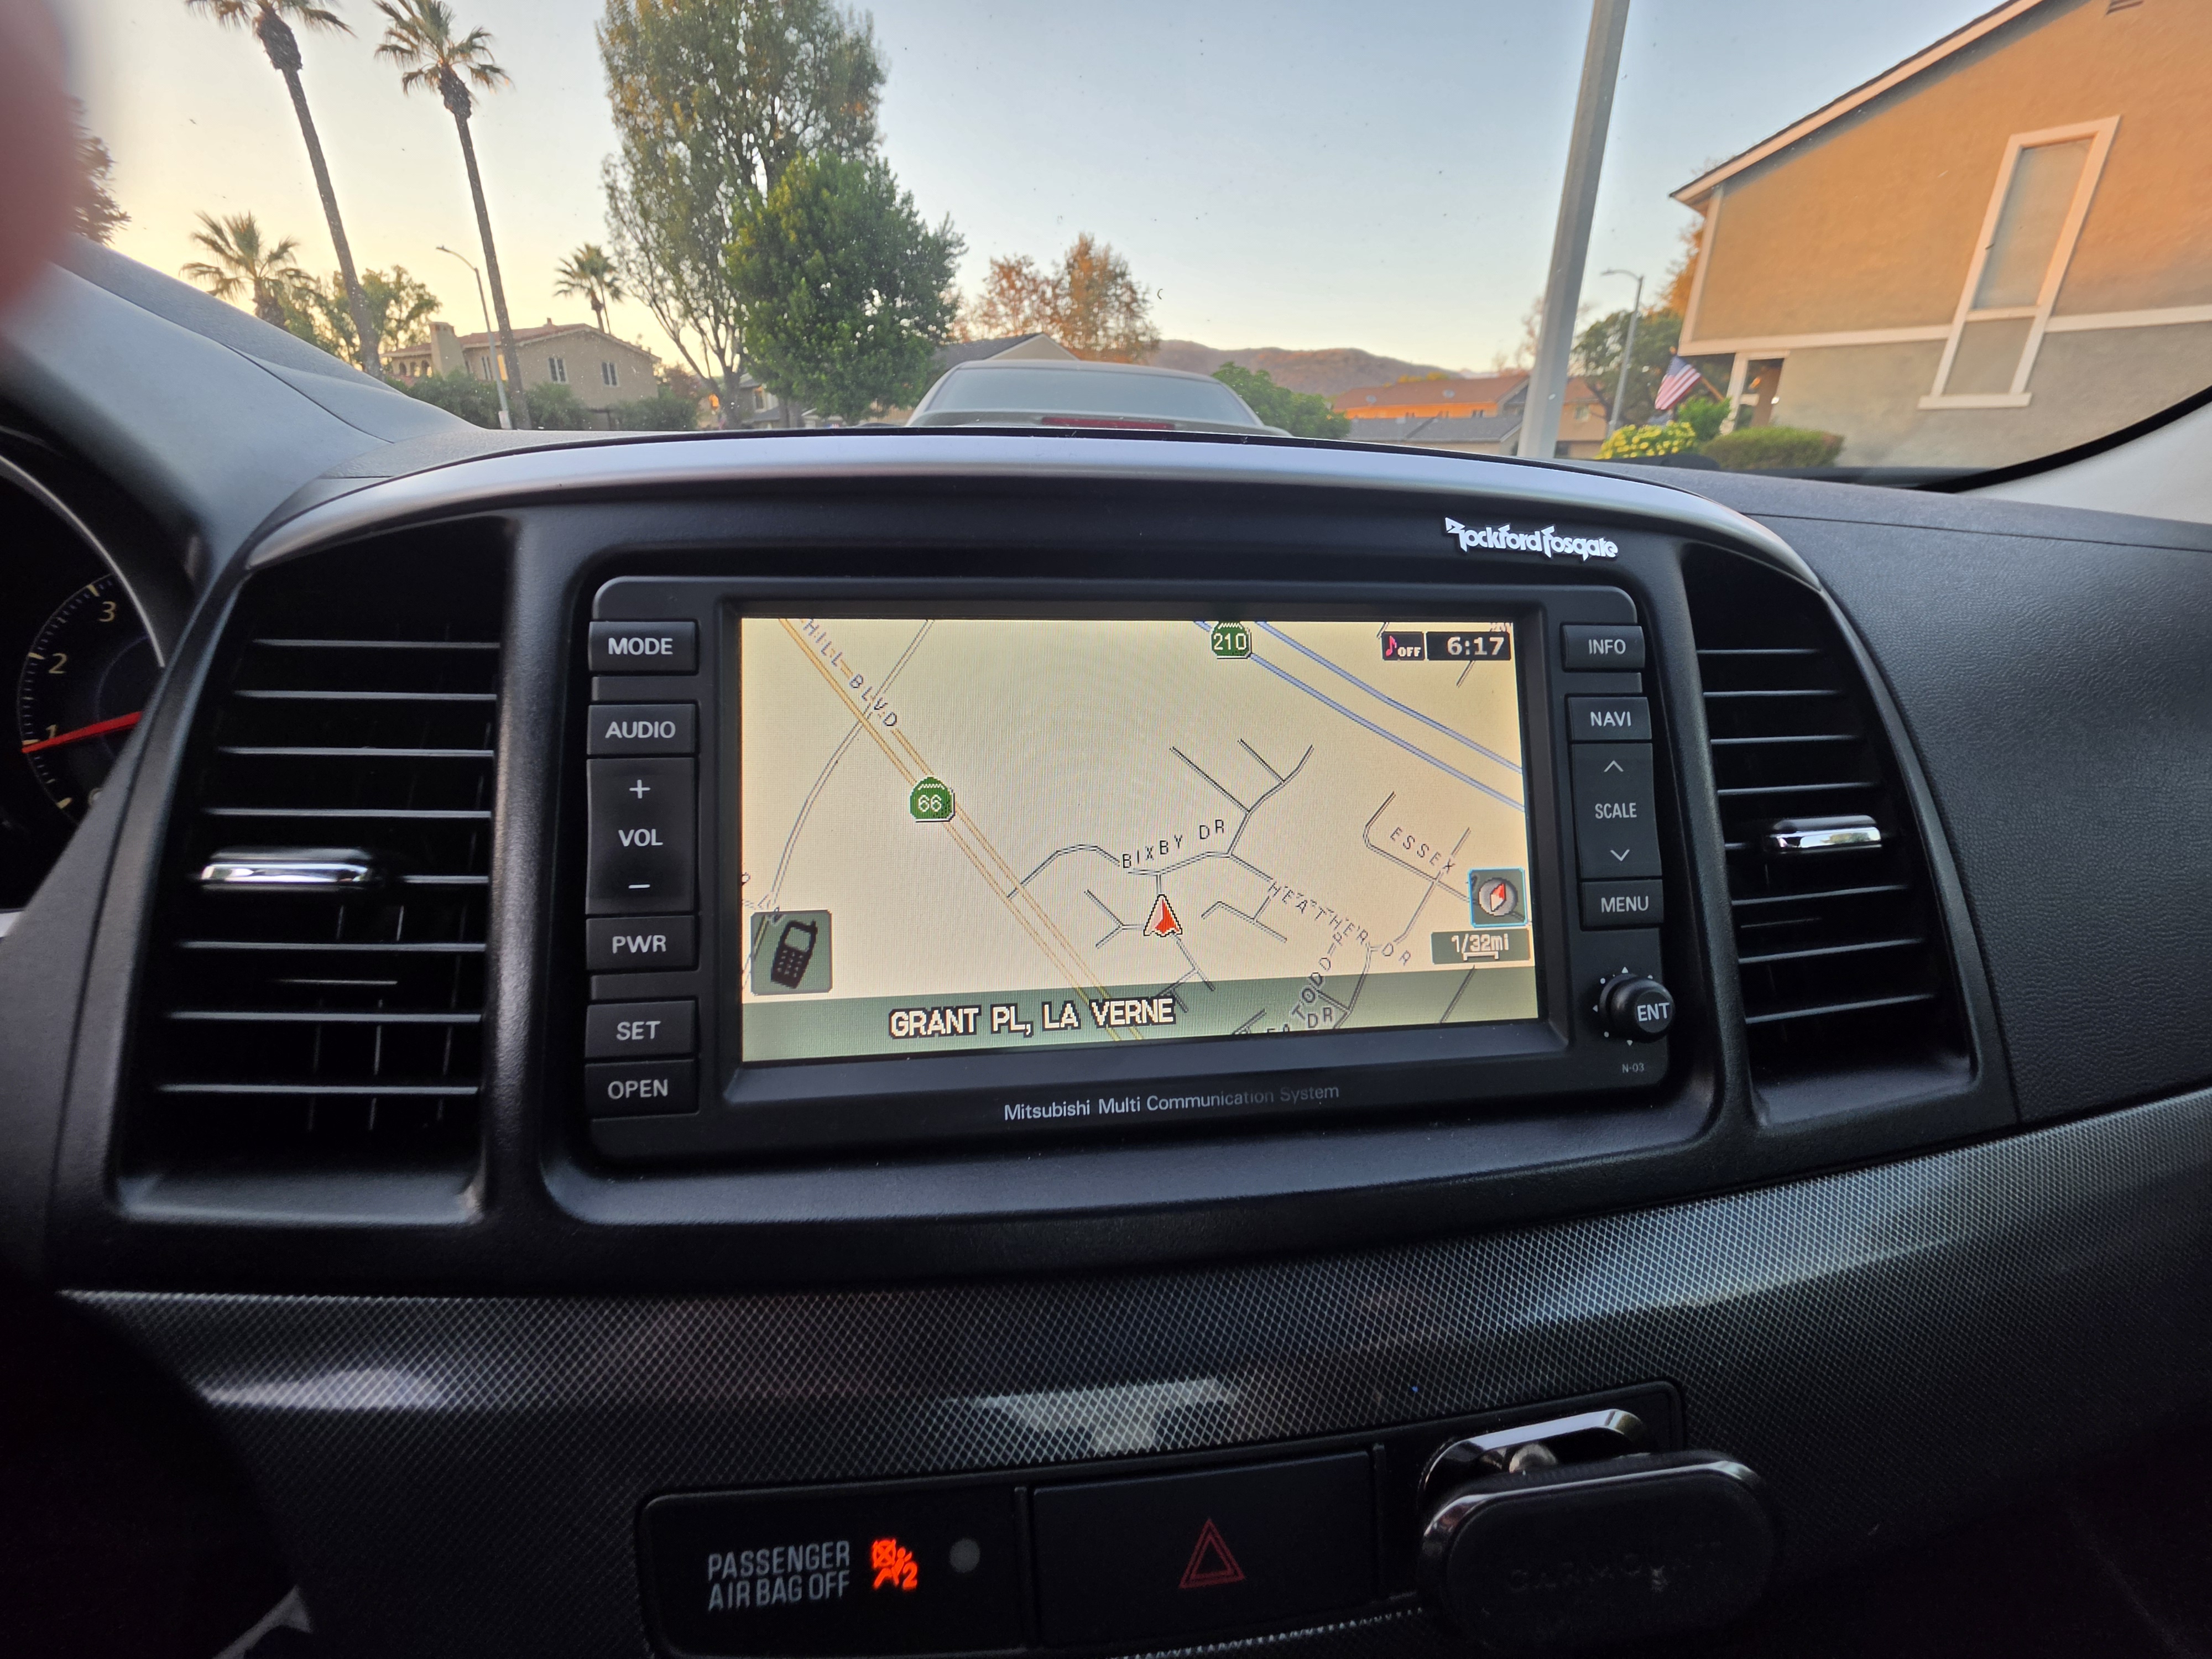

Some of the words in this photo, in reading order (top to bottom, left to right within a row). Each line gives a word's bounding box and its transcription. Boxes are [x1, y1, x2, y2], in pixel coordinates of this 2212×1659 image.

[99, 601, 117, 622] 3
[608, 638, 673, 655] MODE
[1213, 632, 1247, 650] 210
[1447, 637, 1505, 656] 6:17
[1588, 639, 1626, 655] INFO
[1397, 646, 1421, 658] OFF
[48, 653, 66, 674] 2
[802, 619, 843, 666] HILL
[849, 674, 898, 727] BLVD
[1590, 711, 1632, 727] NAVI
[604, 721, 676, 739] AUDIO
[917, 794, 943, 812] 66
[1594, 802, 1637, 820] SCALE
[618, 829, 663, 847] VOL
[1122, 834, 1183, 869] BIXBY
[1199, 819, 1224, 840] DR
[1390, 826, 1455, 874] ESSEX
[1601, 895, 1649, 914] MENU
[1268, 881, 1369, 946] HEATHER
[1381, 942, 1411, 966] DR
[612, 935, 667, 953] PWR
[1451, 933, 1509, 953] 1/32mi
[889, 1008, 979, 1037] GRANT
[993, 1006, 1032, 1036] PL,
[1043, 1004, 1079, 1030] LA
[1091, 998, 1175, 1027] VERNE
[1307, 1007, 1333, 1028] DR
[1637, 1002, 1670, 1022] ENT
[616, 1020, 660, 1041] SET
[1621, 1063, 1645, 1073] N-03
[607, 1079, 669, 1099] OPEN
[1004, 1099, 1091, 1121] Mitsubishi
[1098, 1096, 1141, 1115] Multi
[1147, 1092, 1275, 1112] Communication
[1280, 1086, 1340, 1104] System
[707, 1540, 851, 1580] PASSENGER
[707, 1582, 751, 1612] AIR
[755, 1575, 803, 1607] BAG
[807, 1569, 851, 1601] OFF
